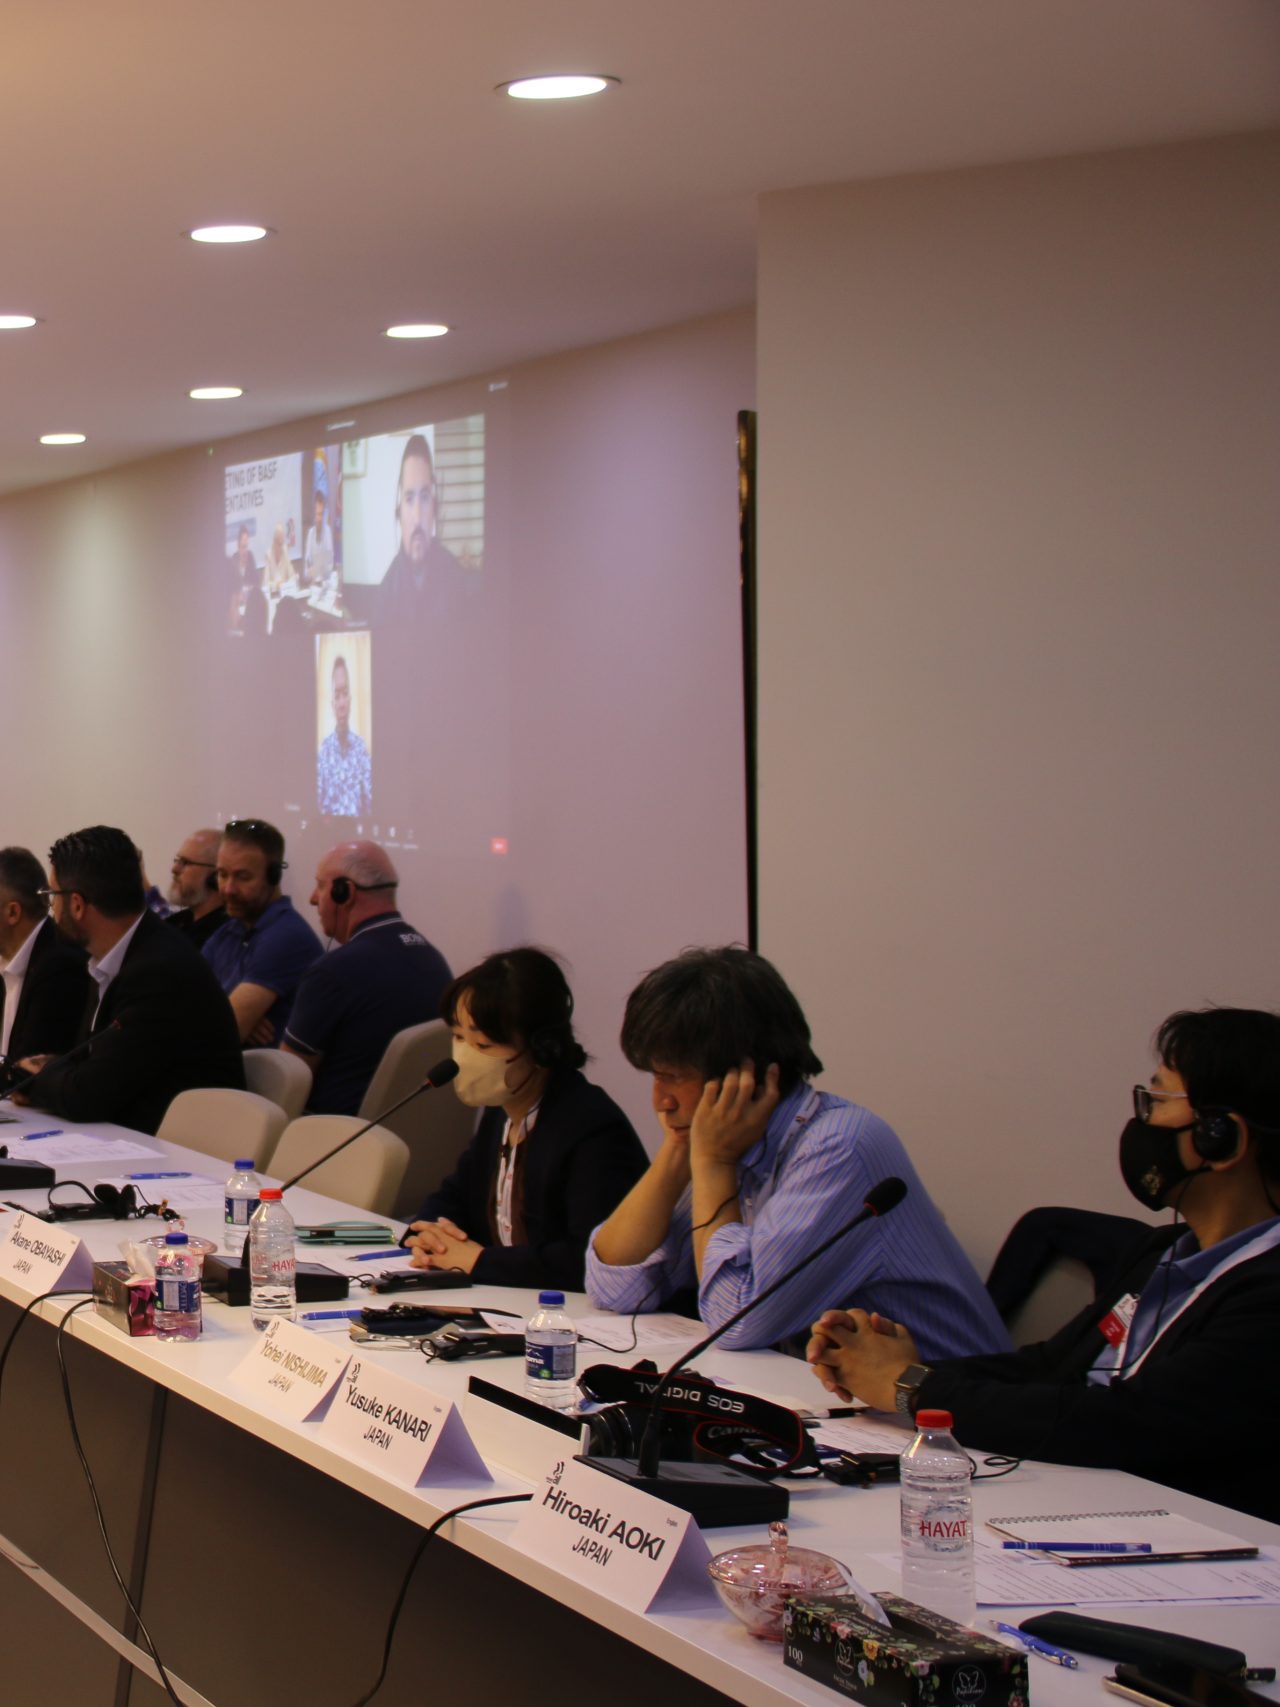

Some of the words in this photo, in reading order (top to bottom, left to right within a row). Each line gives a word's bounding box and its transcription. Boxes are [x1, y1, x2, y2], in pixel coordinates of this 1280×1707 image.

[30, 1239, 67, 1267] OBAYASHI
[260, 1339, 288, 1364] Yohei
[345, 1384, 384, 1419] Yusuke
[382, 1403, 433, 1443] KANARI
[707, 1394, 745, 1414] EOS
[363, 1424, 394, 1451] JAPAN
[542, 1485, 612, 1535] Hiroaki
[607, 1519, 666, 1562] AOKI
[919, 1519, 968, 1538] HAYAT
[572, 1535, 613, 1567] JAPAN
[788, 1645, 804, 1662] 100
